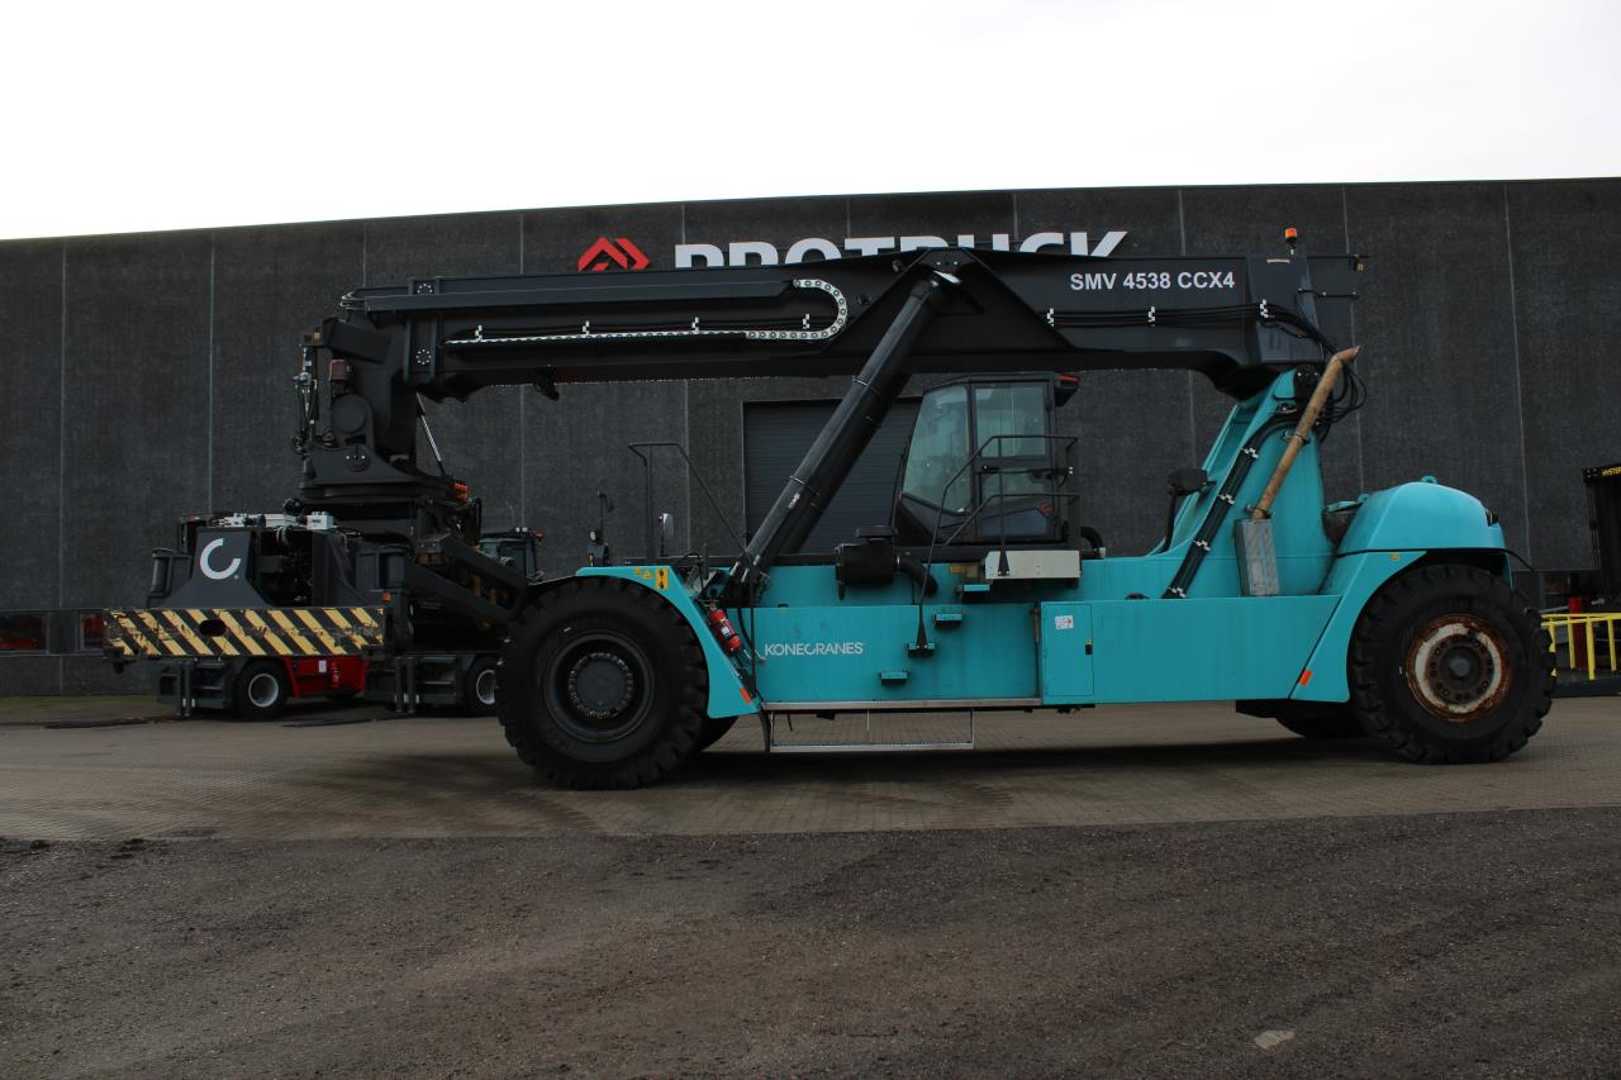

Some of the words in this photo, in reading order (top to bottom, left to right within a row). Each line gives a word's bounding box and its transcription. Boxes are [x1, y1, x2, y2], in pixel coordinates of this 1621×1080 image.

[1070, 273, 1117, 290] SMV
[1122, 272, 1171, 289] 4538
[1177, 271, 1236, 289] CCX4
[764, 642, 864, 656] KONECRANES
